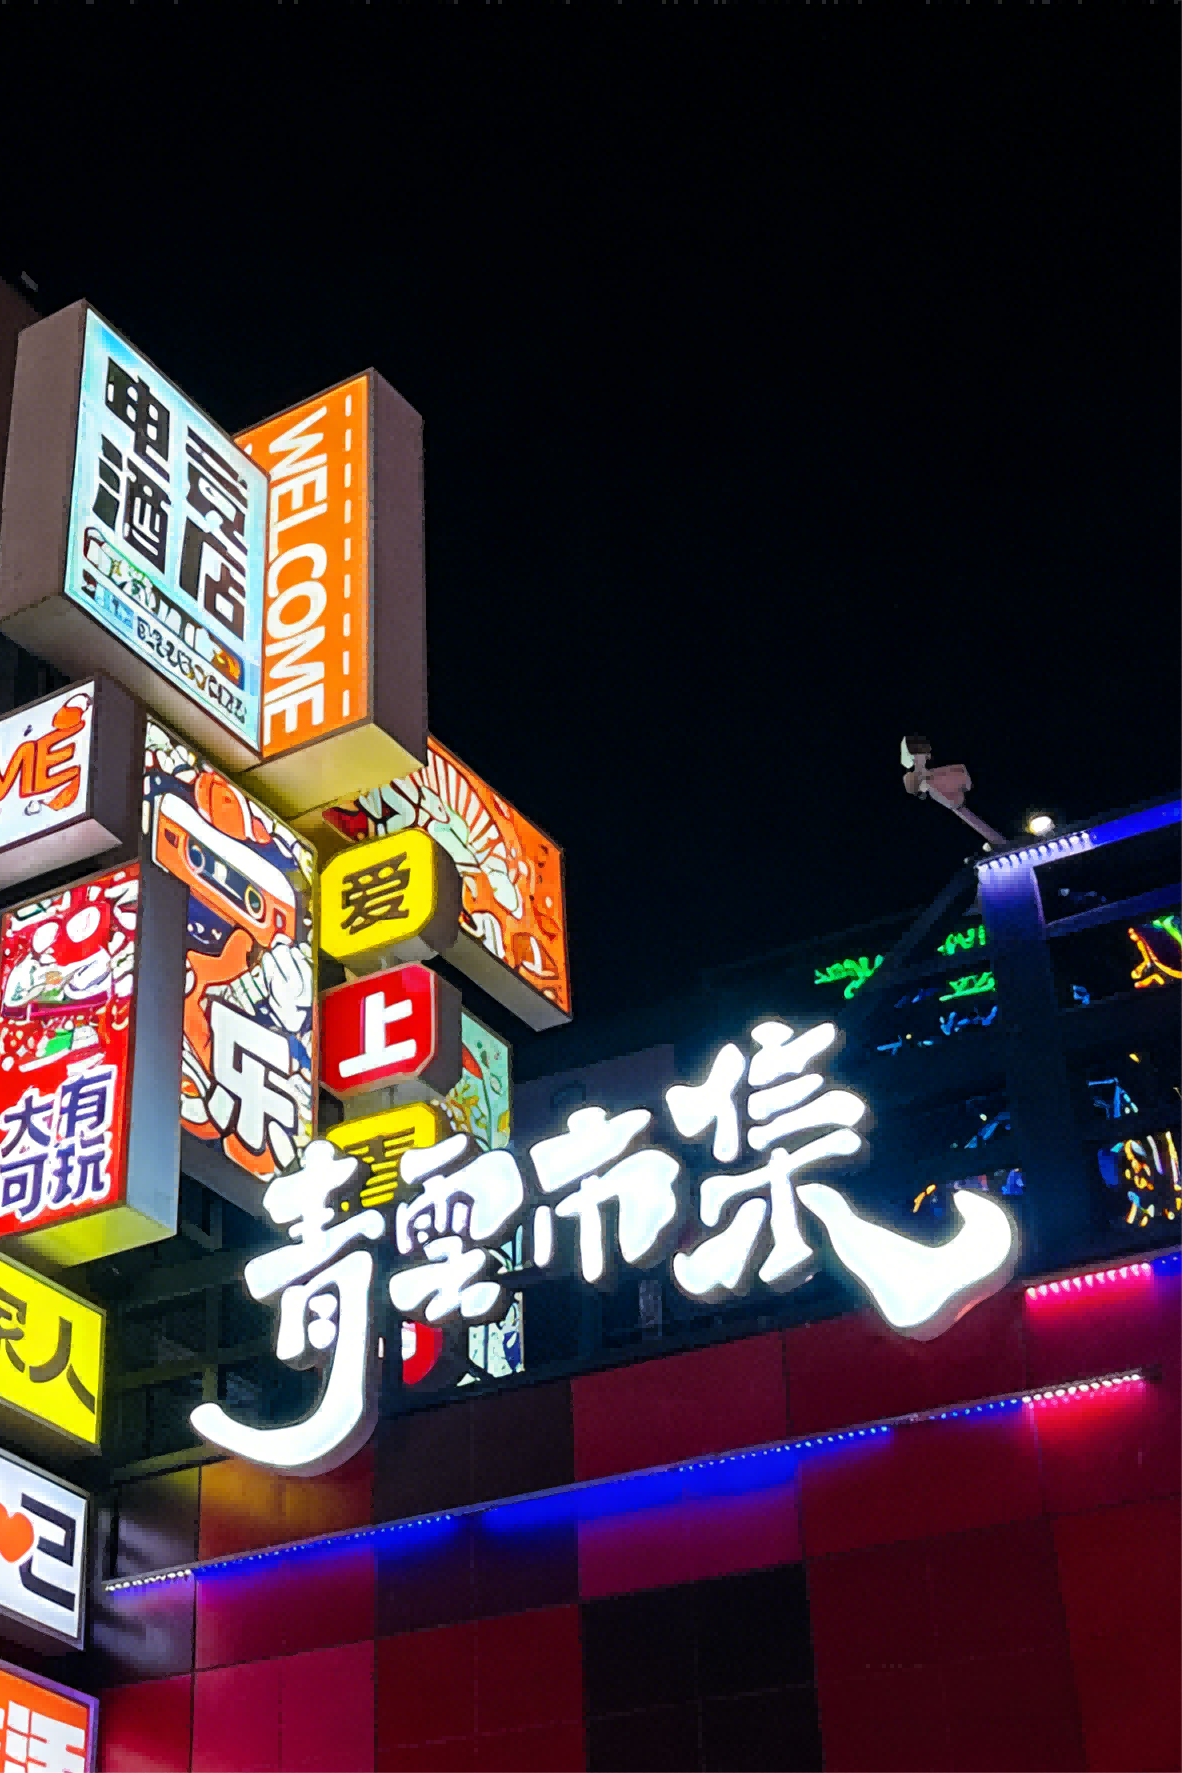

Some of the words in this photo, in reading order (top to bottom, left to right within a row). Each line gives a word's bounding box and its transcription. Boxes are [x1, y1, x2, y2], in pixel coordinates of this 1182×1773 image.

[263, 405, 328, 745] WELCOME
[341, 851, 411, 936] 爱
[339, 992, 418, 1078] 上
[0, 1067, 117, 1159] 大有
[208, 1000, 299, 1170] 乐
